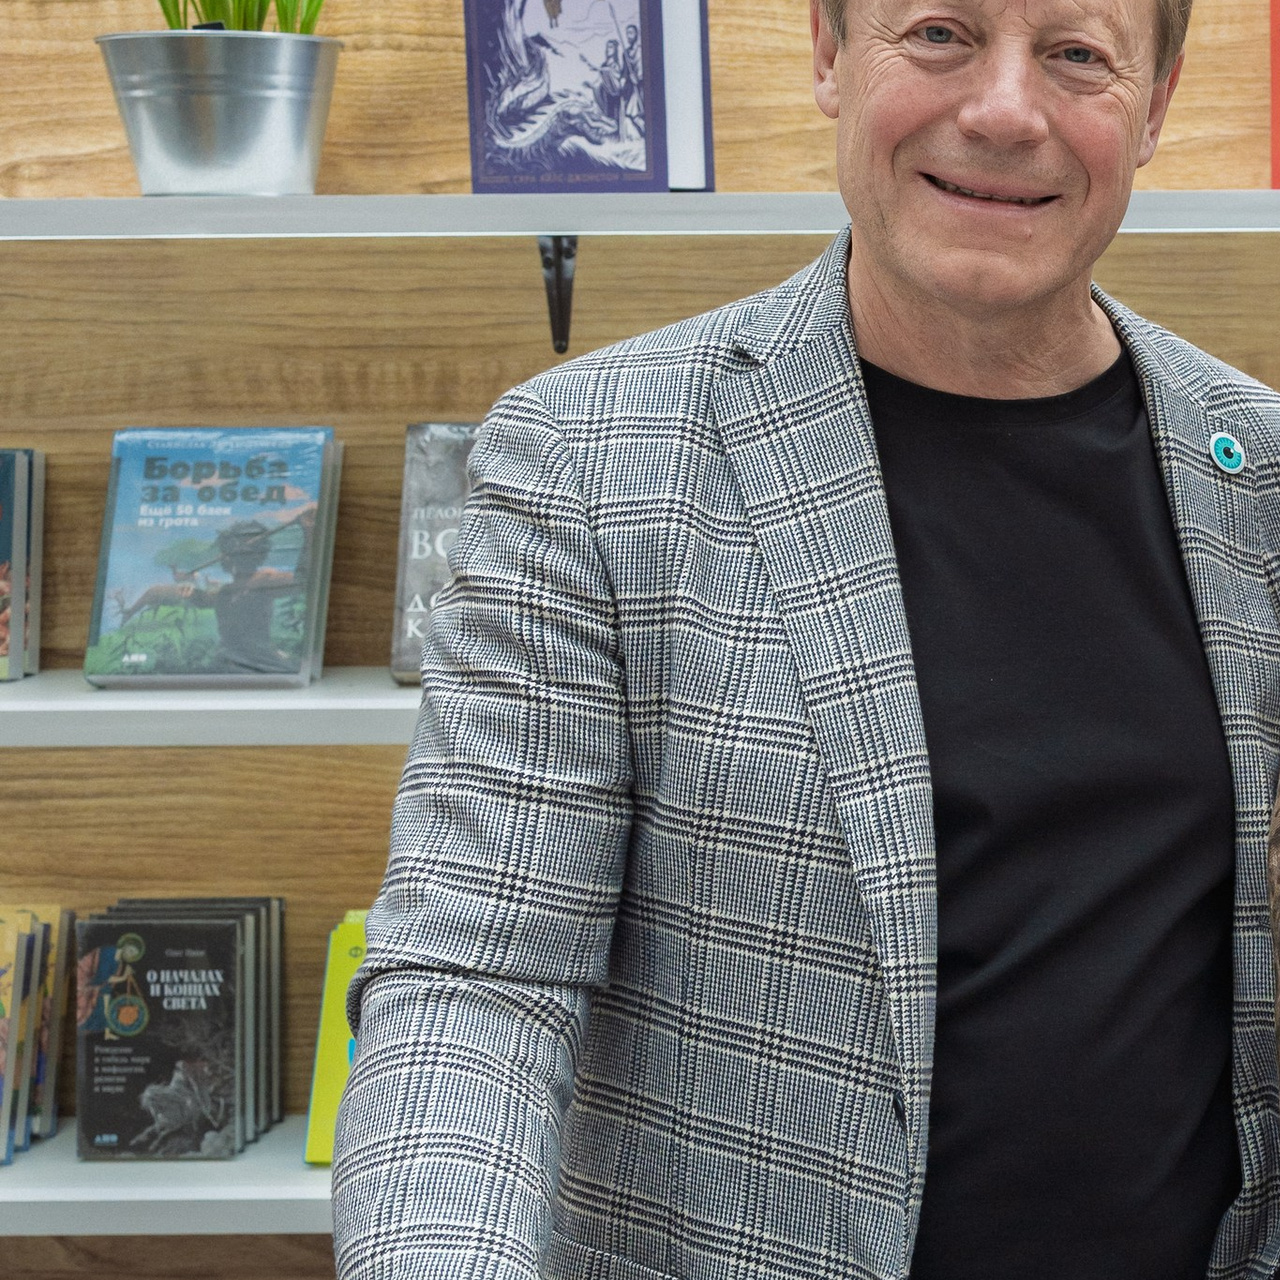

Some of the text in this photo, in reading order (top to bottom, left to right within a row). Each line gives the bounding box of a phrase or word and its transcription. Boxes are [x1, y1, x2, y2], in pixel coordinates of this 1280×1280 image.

[143, 455, 289, 484] Борьба
[141, 481, 287, 505] за обед
[146, 969, 158, 983] О
[163, 996, 207, 1011] СВЕТА
